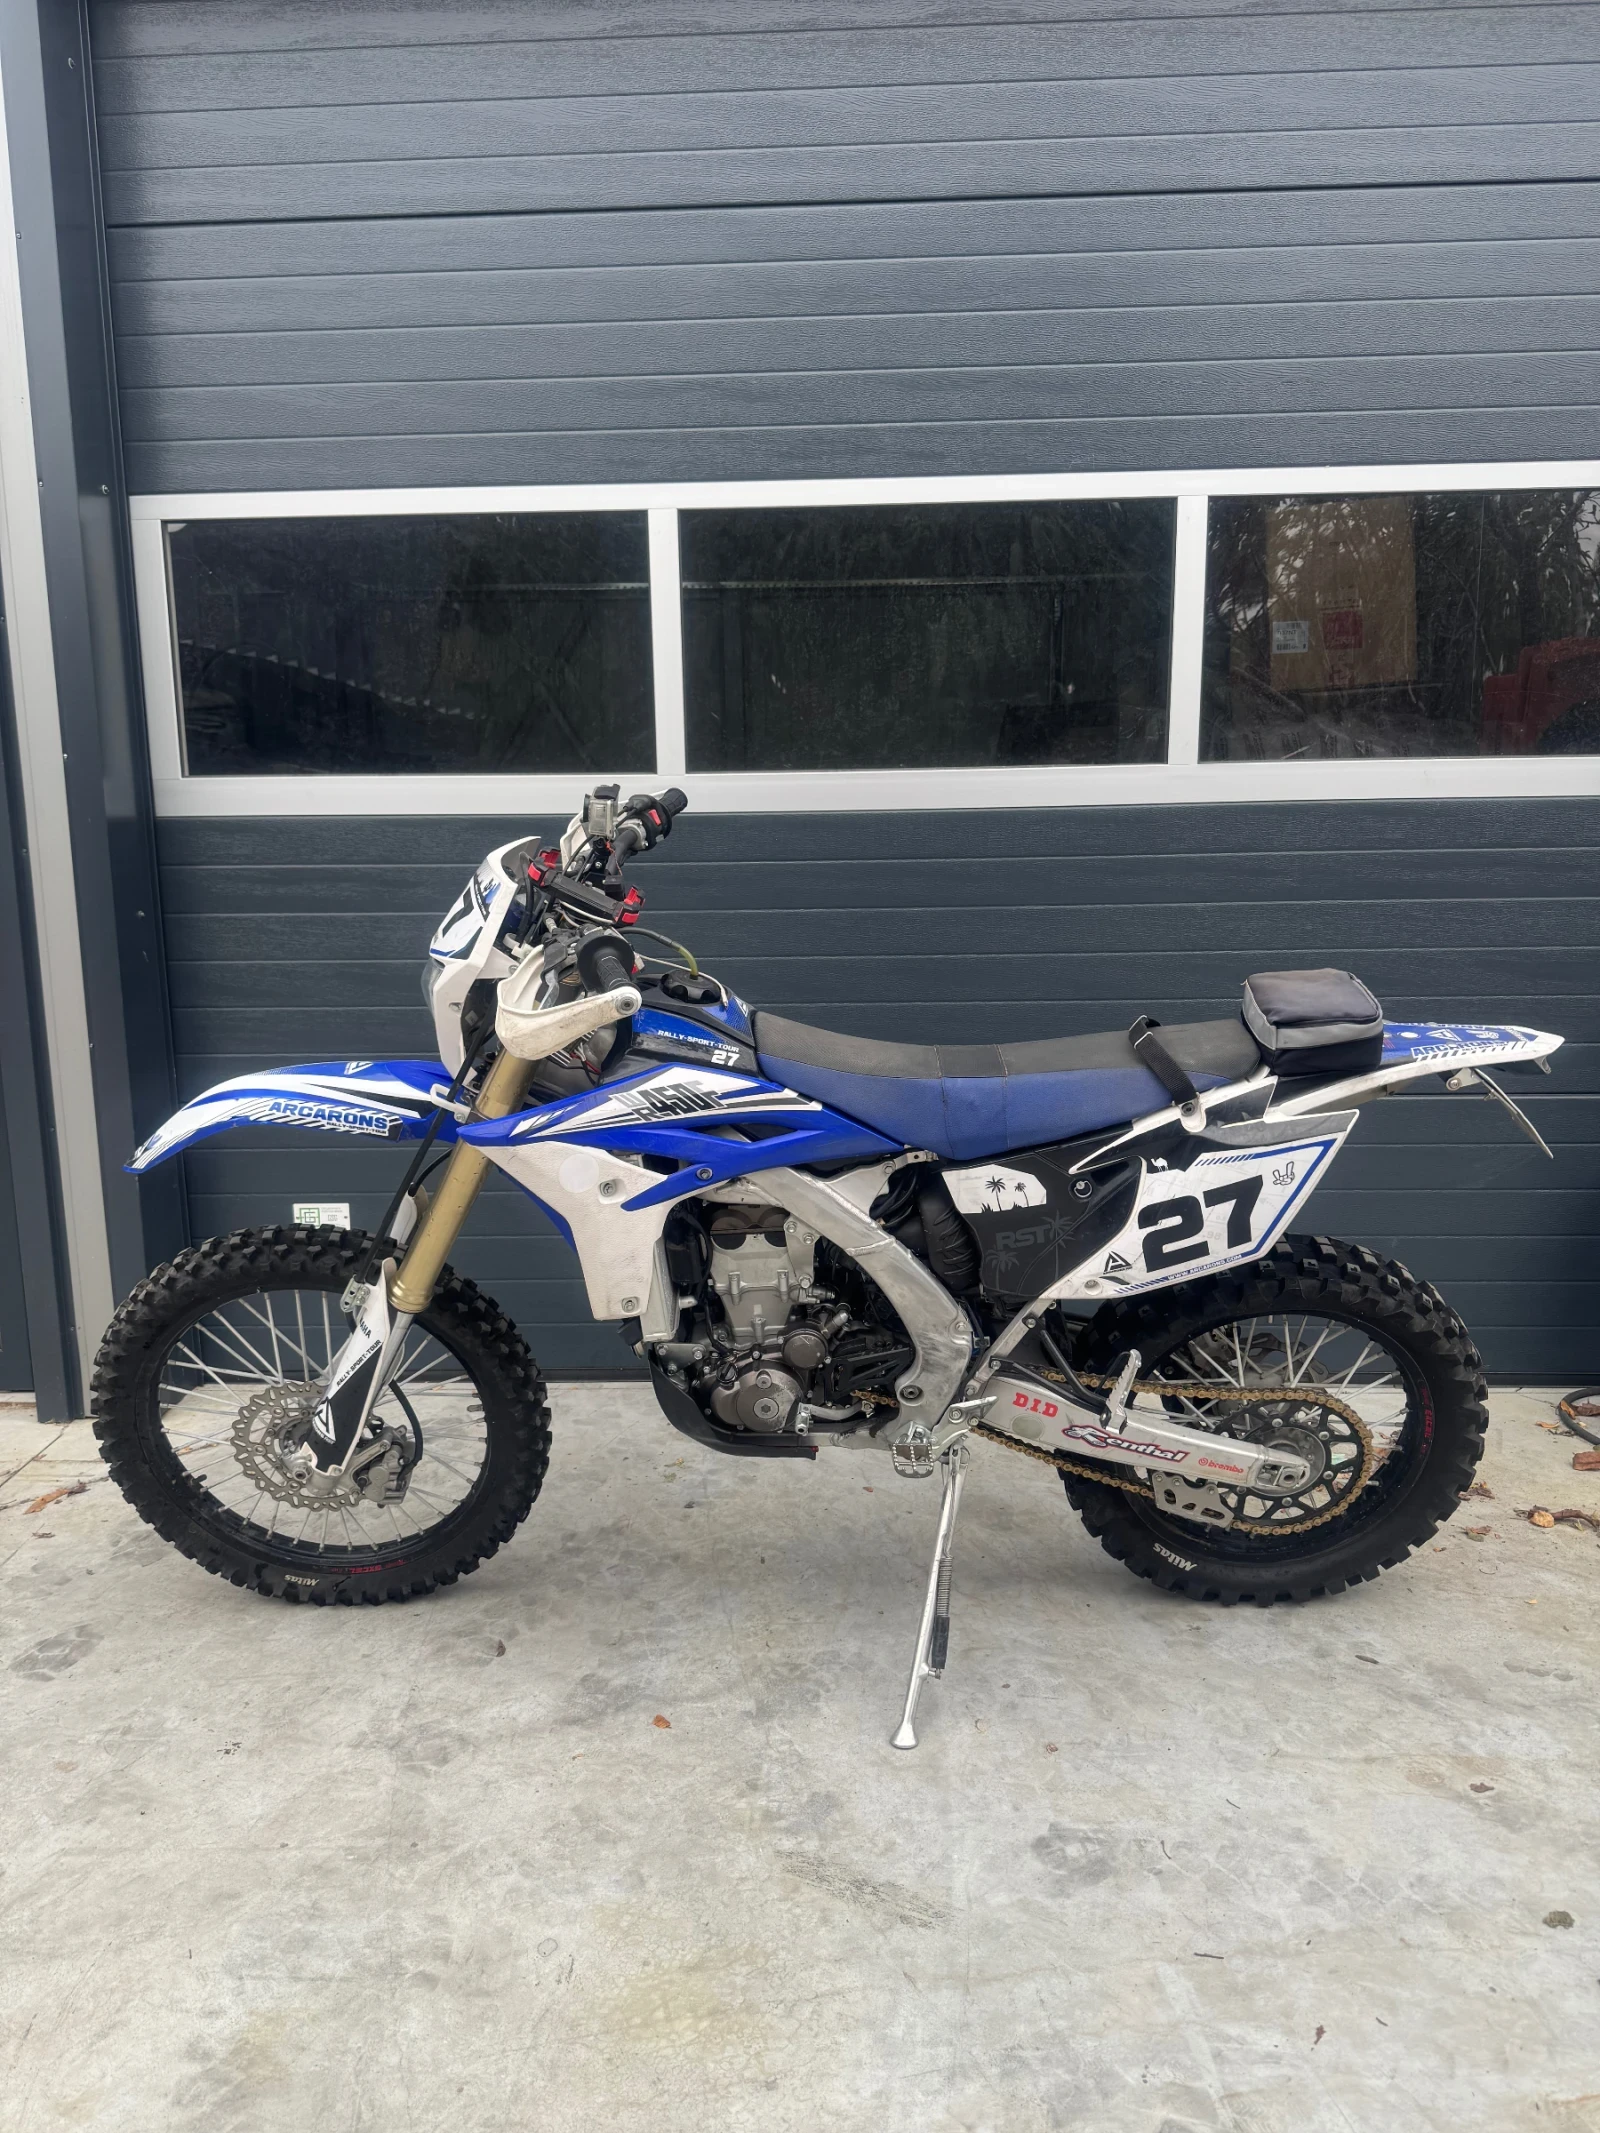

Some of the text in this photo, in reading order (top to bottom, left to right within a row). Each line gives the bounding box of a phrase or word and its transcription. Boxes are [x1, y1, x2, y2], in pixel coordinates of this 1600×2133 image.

[657, 1029, 740, 1053] RALLY-SPORT-TOUR
[710, 1050, 740, 1067] 27
[269, 1101, 390, 1130] ARCARONS
[1137, 1174, 1264, 1273] 27
[996, 1223, 1052, 1251] RST
[1207, 1459, 1244, 1474] brembo
[1152, 1542, 1198, 1572] Mitas
[284, 1574, 320, 1587] Mitas
